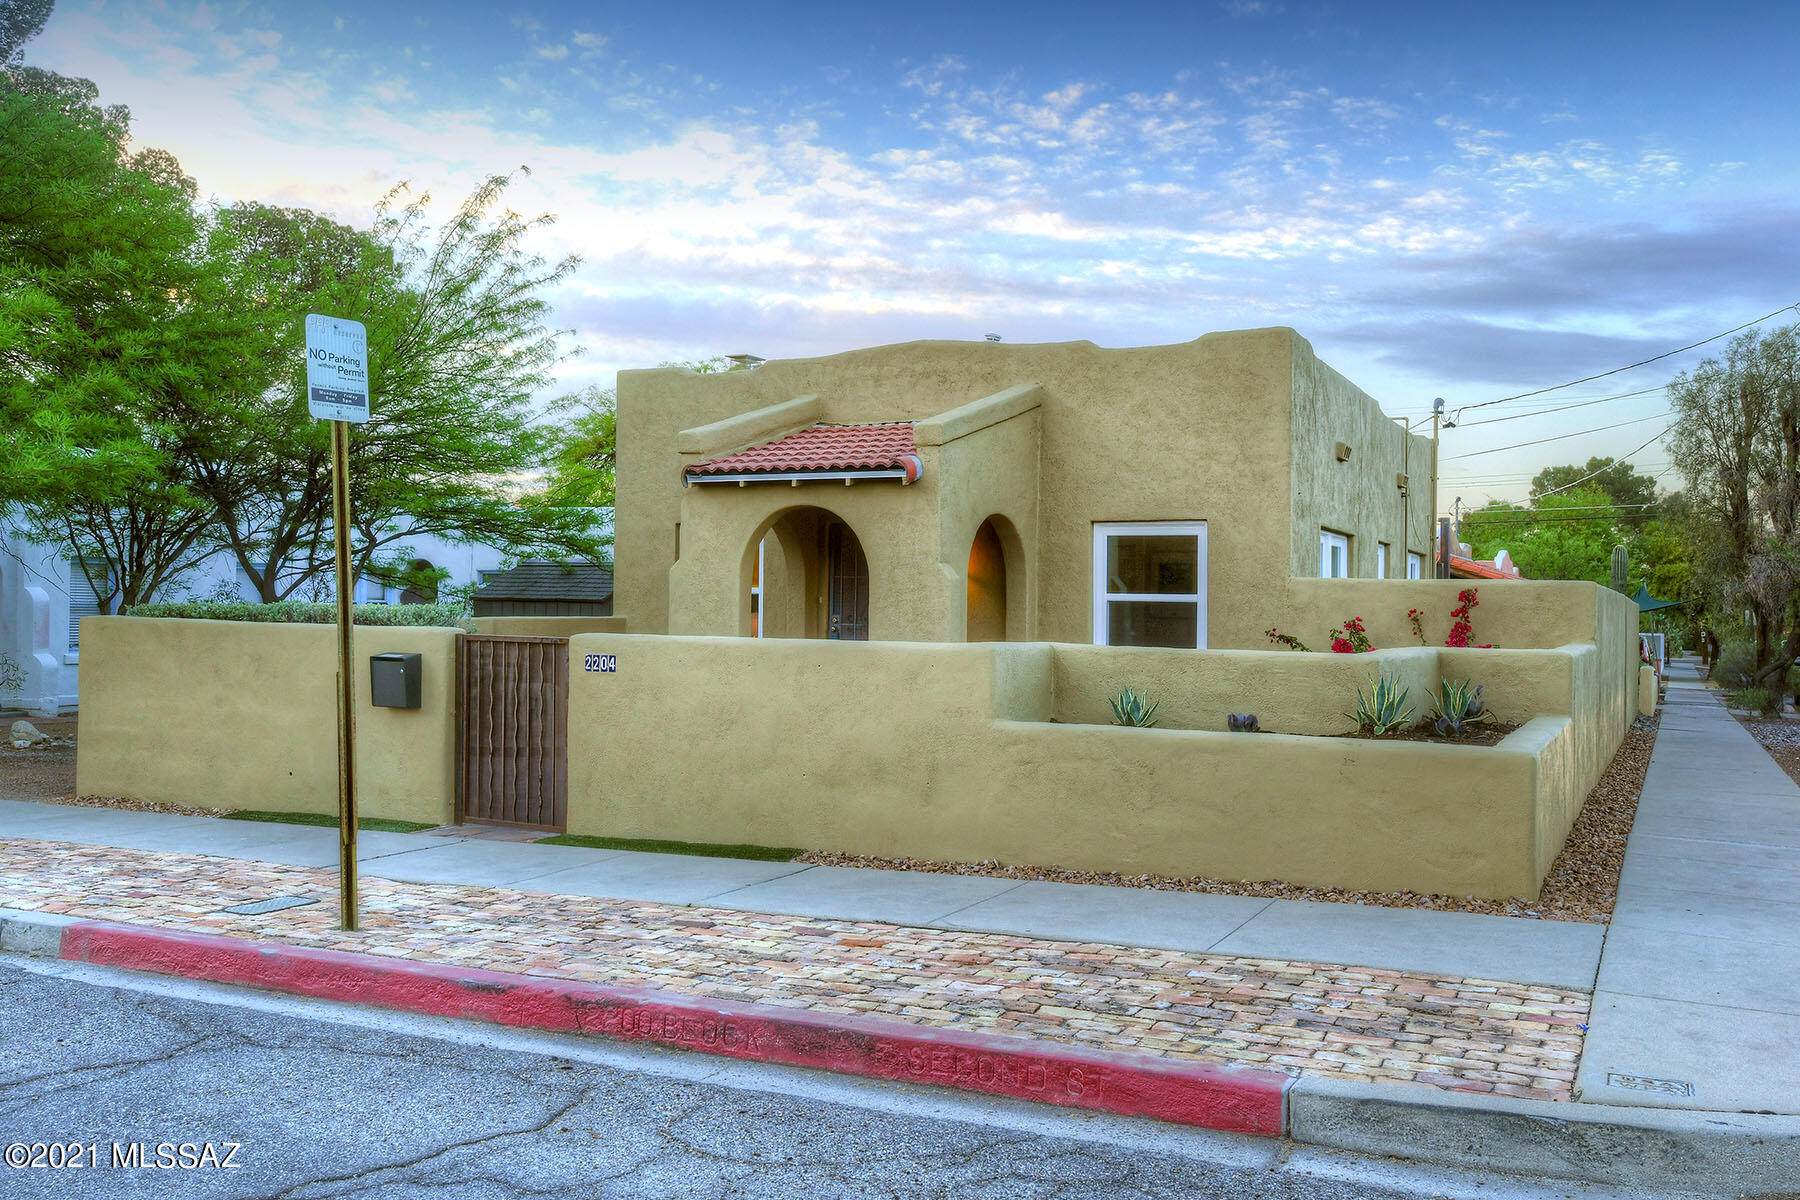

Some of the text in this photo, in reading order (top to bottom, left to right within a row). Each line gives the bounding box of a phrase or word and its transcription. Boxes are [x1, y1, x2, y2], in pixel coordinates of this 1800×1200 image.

[309, 348, 360, 368] NO Parking
[338, 365, 365, 378] Permit
[585, 656, 616, 671] 2204
[662, 1014, 760, 1053] BLOCK
[906, 1047, 1046, 1092] SECOND
